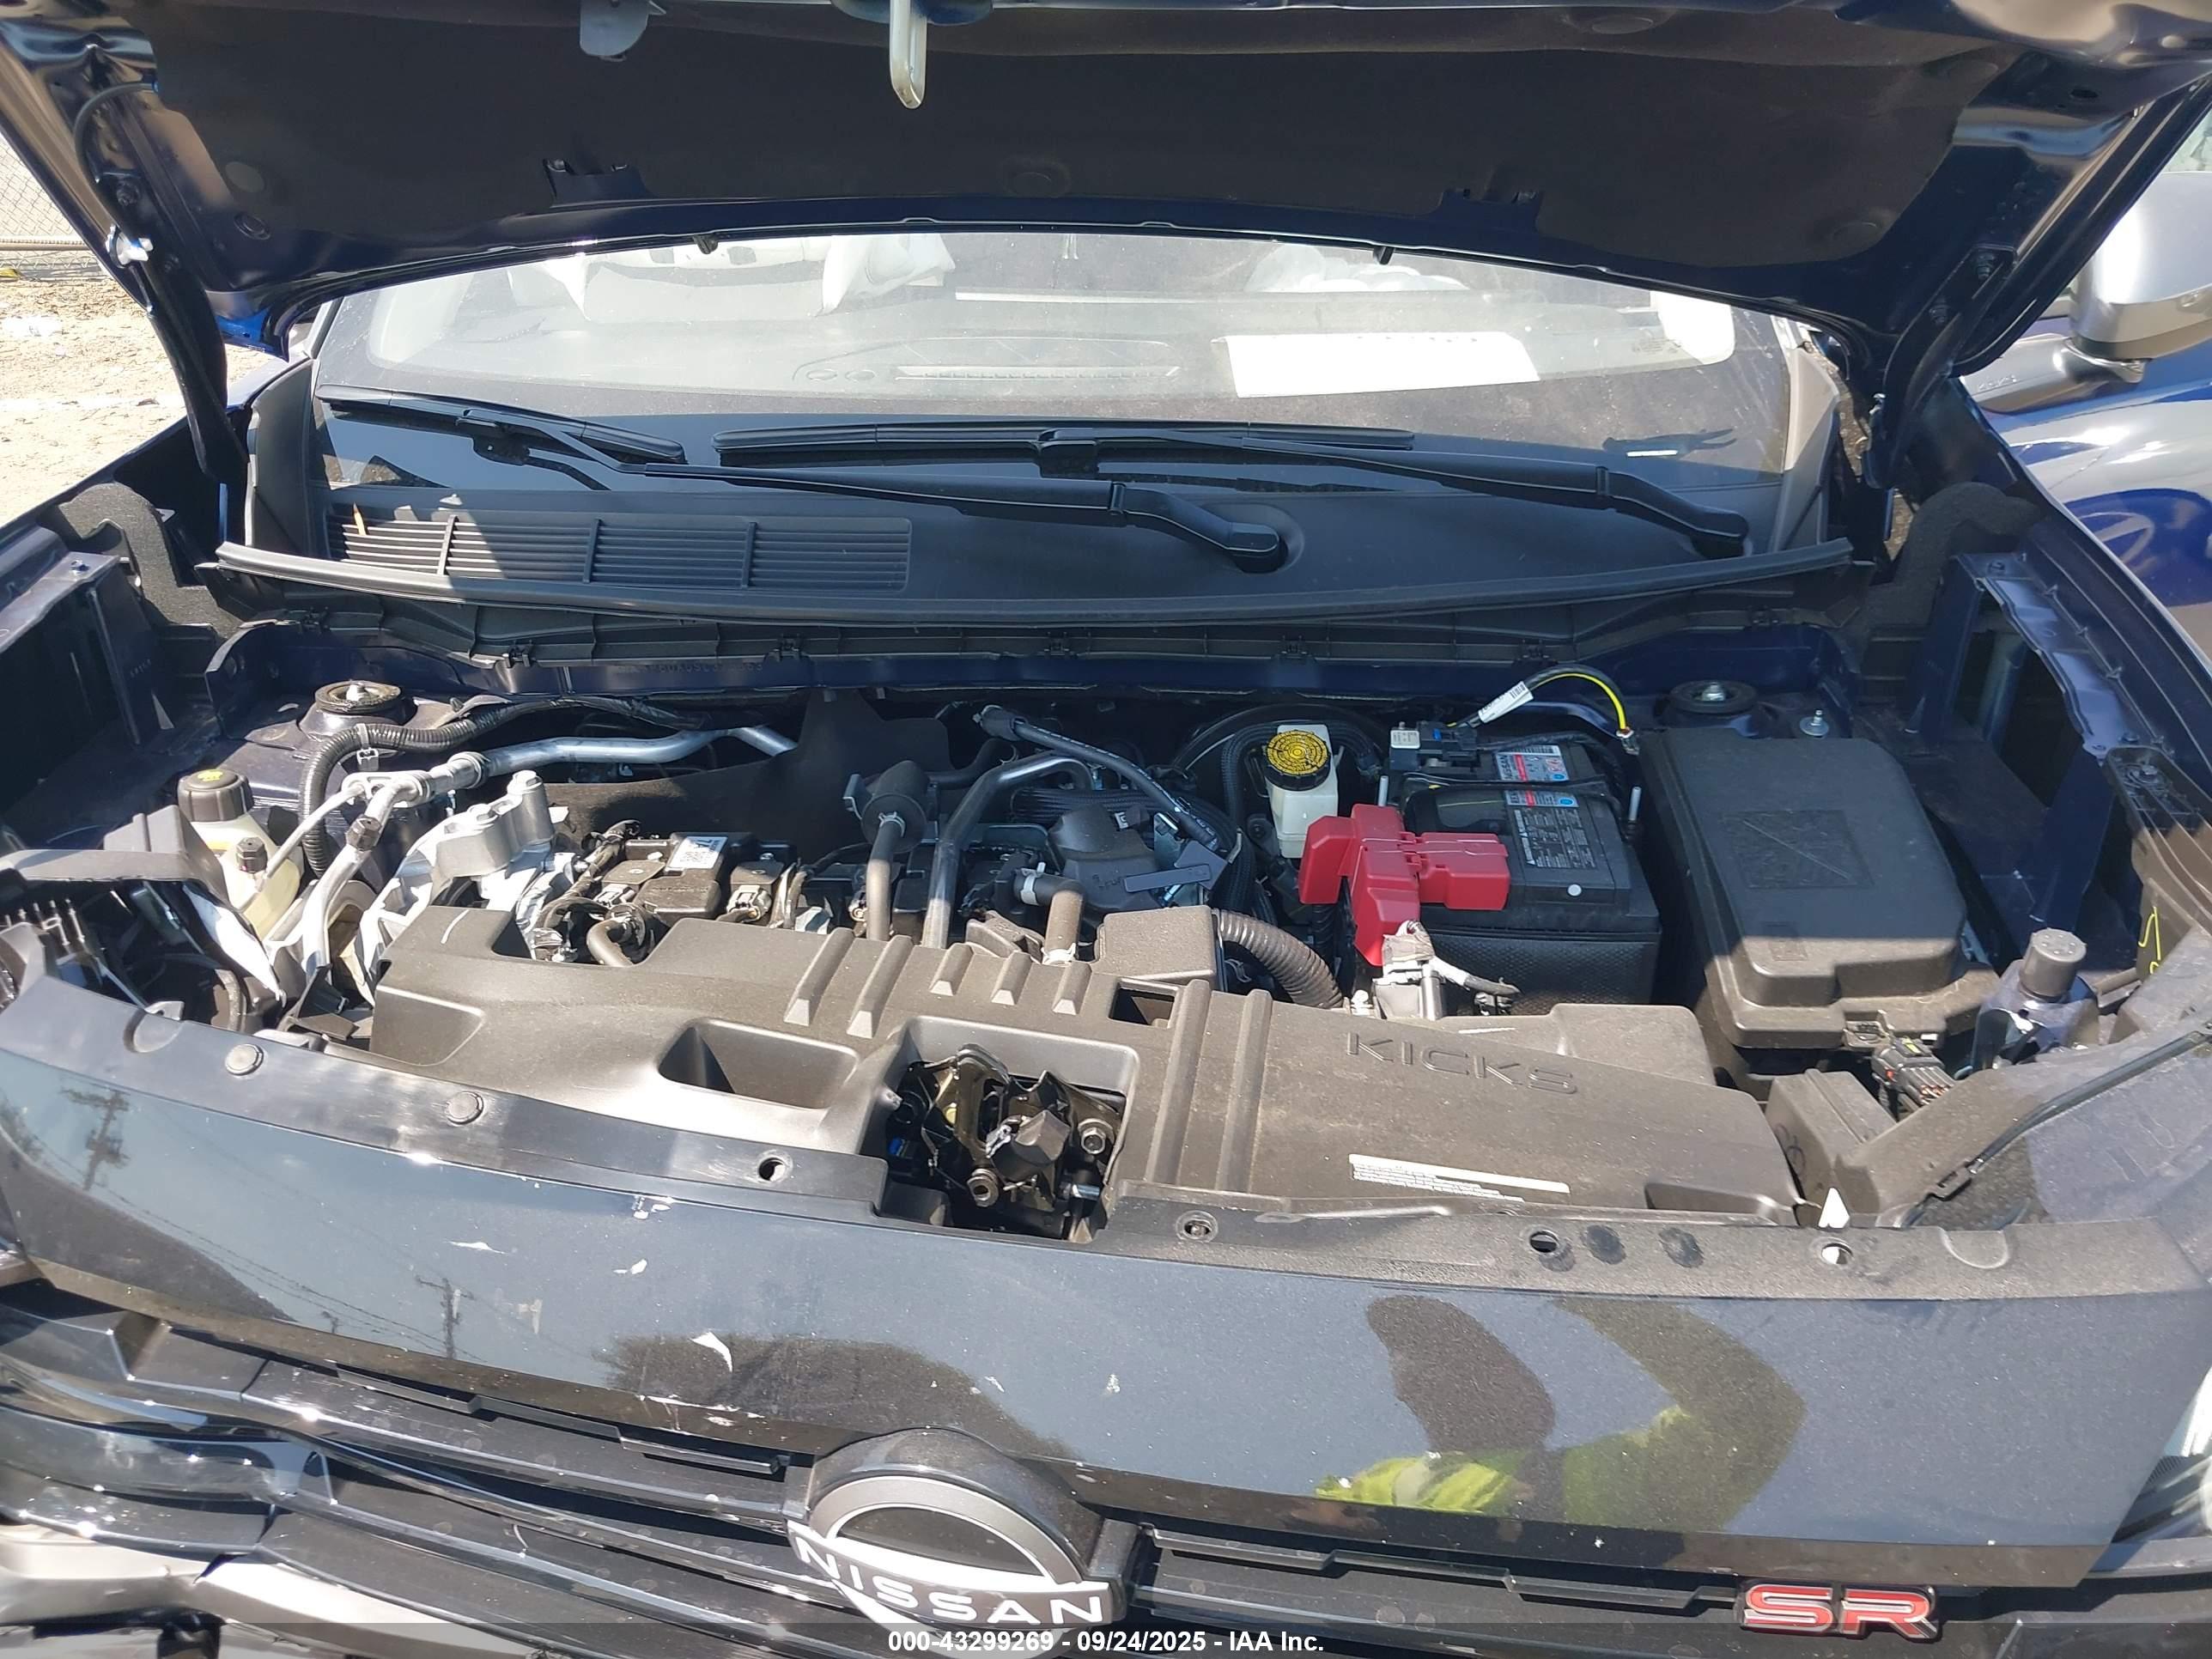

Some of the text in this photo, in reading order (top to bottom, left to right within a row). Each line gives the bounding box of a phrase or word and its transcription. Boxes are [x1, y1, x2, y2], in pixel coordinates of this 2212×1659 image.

[1346, 1032, 1578, 1095] KICKS
[795, 1539, 1103, 1625] NISSAN
[1744, 1584, 1938, 1639] SR
